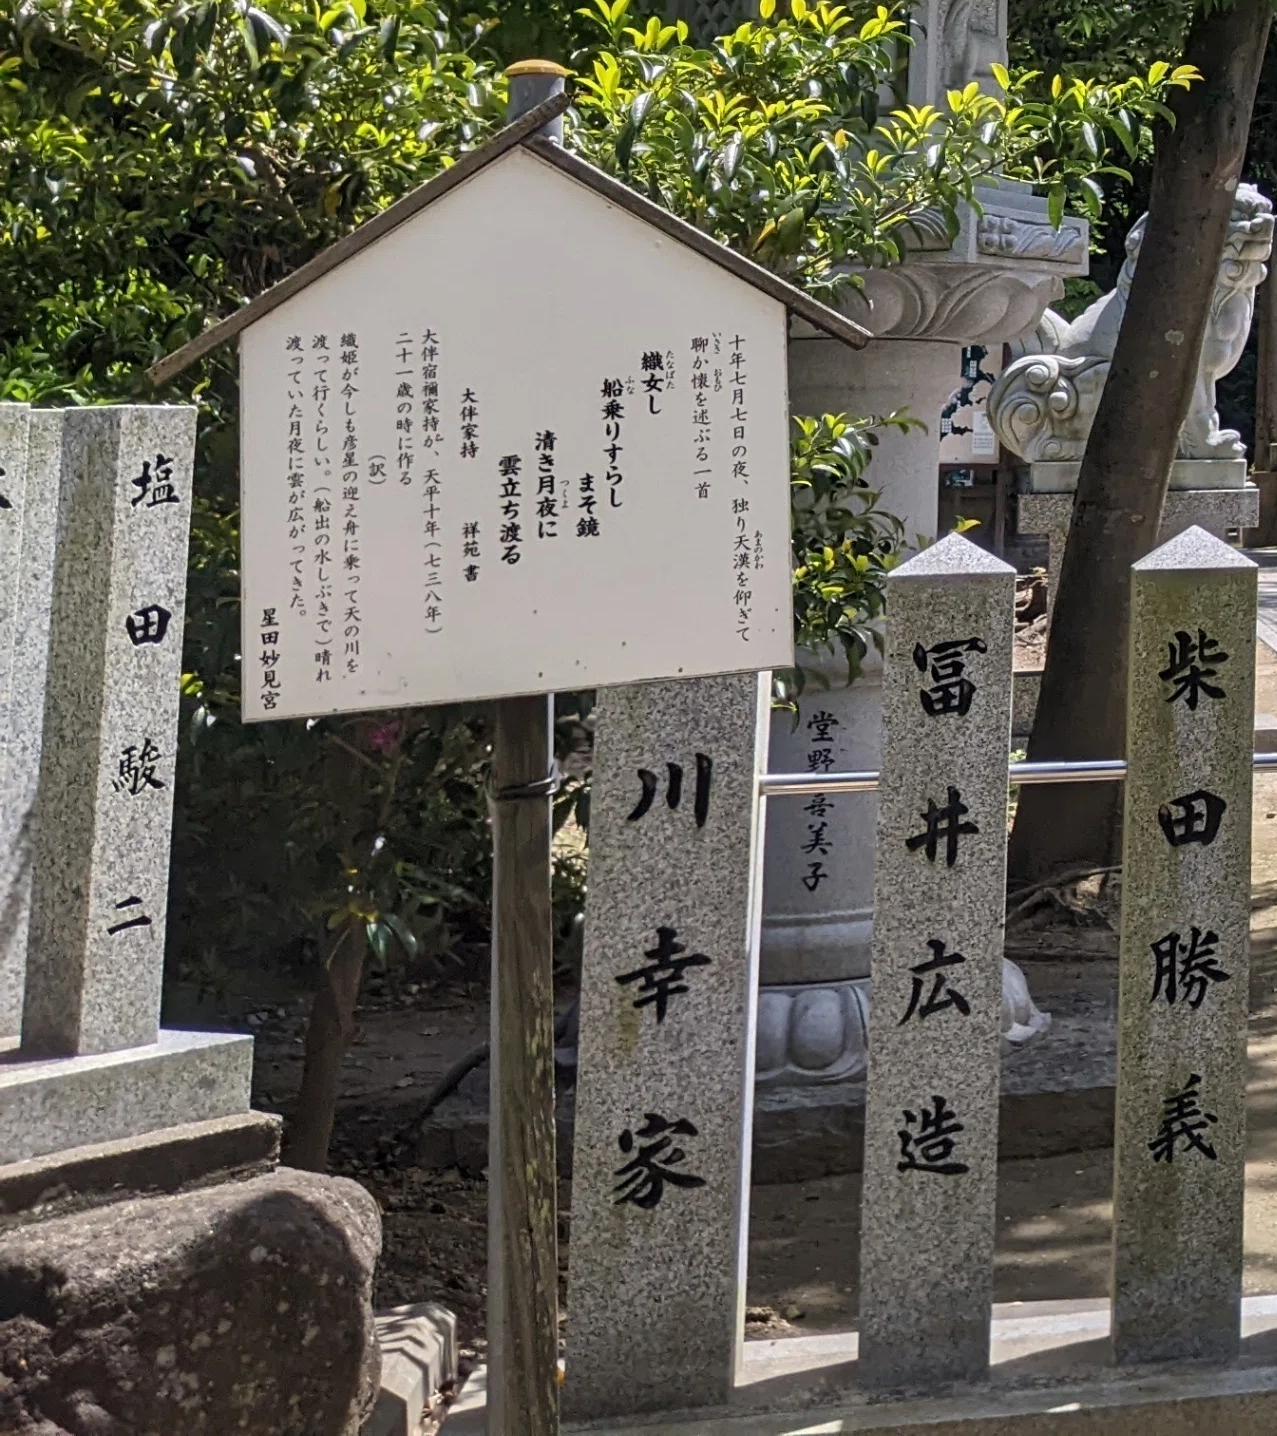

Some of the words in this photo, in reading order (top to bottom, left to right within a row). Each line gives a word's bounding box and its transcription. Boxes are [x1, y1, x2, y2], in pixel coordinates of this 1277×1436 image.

[395, 332, 414, 485] 二十一歳の時に作る
[460, 388, 479, 458] 大伴家持
[625, 376, 635, 394] ふな
[641, 351, 664, 414] 織女し
[666, 350, 675, 389] たなばた
[286, 335, 306, 616] 渡っていた月夜に雲が広がってきた。
[535, 430, 559, 539] 清き月夜に
[600, 378, 625, 507] 船乗りすらし
[499, 454, 523, 565] 雲立ち渡る
[576, 473, 600, 537] まそ鏡
[106, 459, 181, 936] 塩田駿二
[259, 607, 281, 710] 星田妙見宮
[1148, 629, 1232, 1164] 柴田勝義
